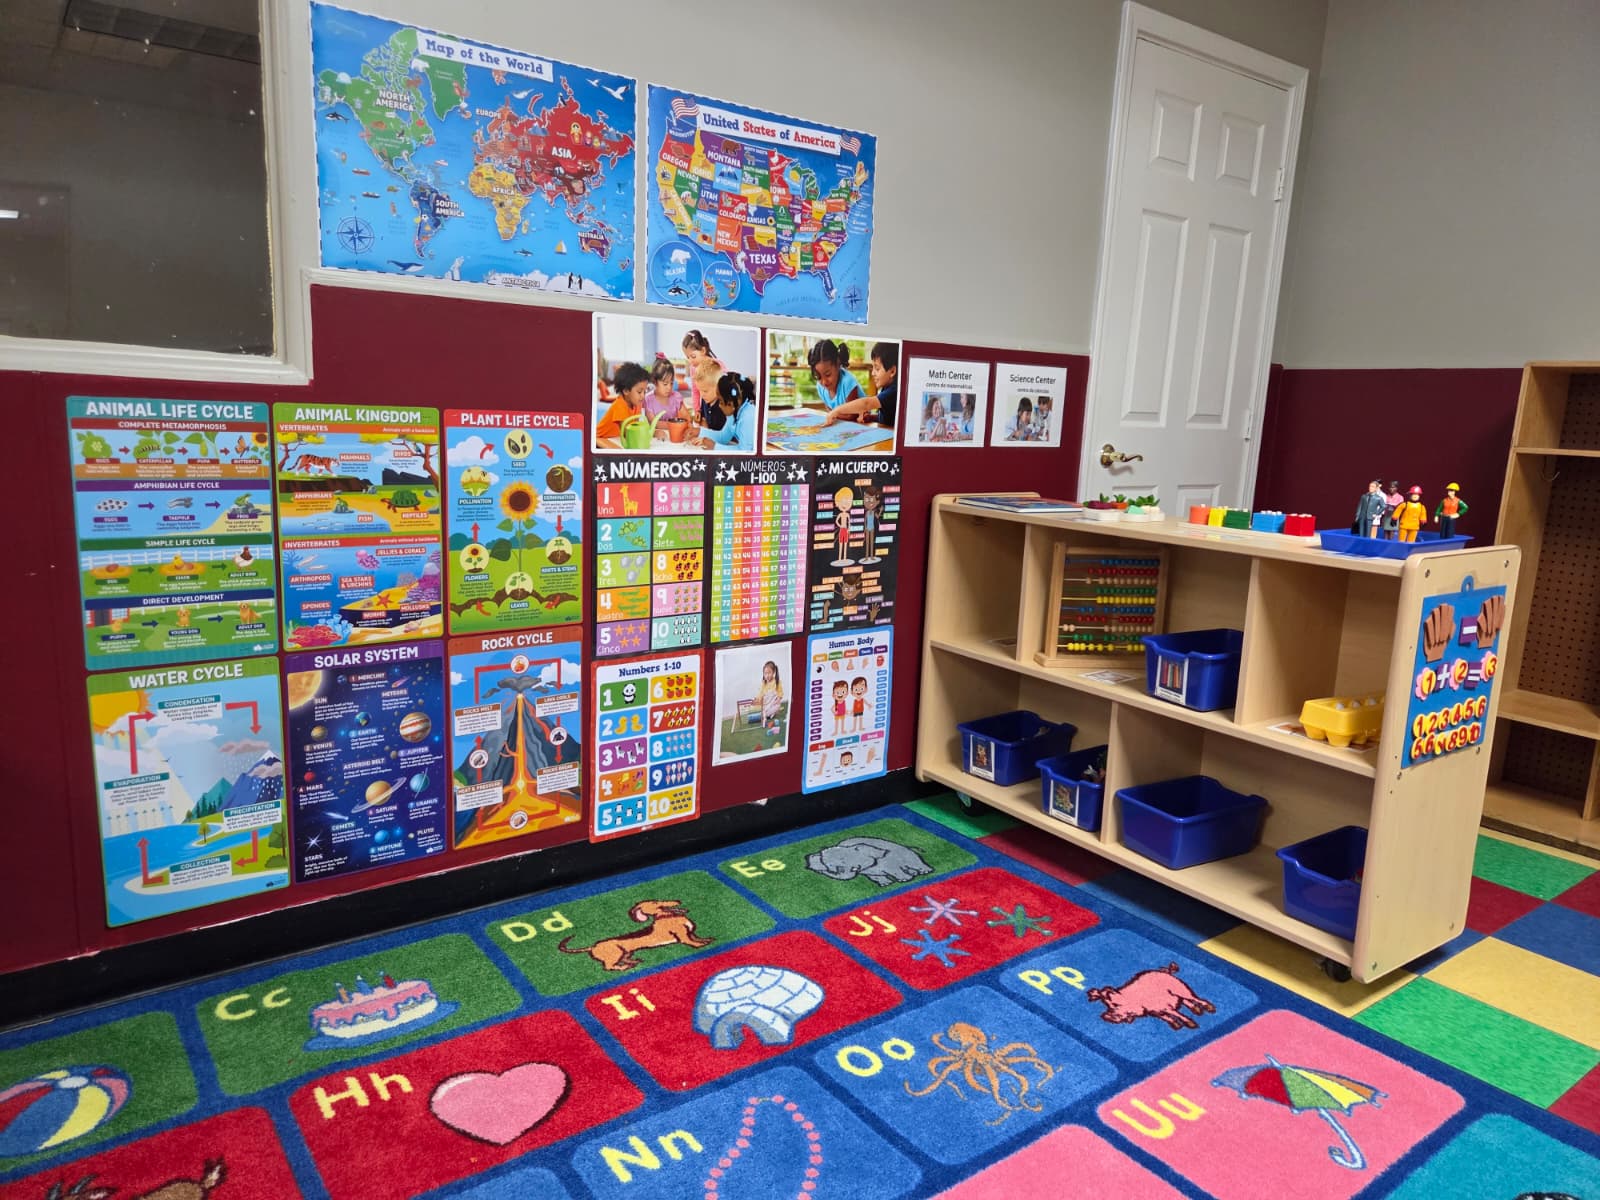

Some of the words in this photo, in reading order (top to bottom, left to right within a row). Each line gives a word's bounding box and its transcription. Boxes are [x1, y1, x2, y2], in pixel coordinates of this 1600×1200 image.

[426, 39, 454, 57] Map
[460, 48, 473, 59] of
[479, 51, 500, 65] the
[506, 57, 544, 74] World
[379, 90, 410, 102] NORTH
[376, 98, 414, 111] AMERICA
[476, 108, 501, 119] EUROPE
[703, 113, 739, 130] United
[743, 121, 776, 137] States
[780, 131, 790, 140] of
[794, 131, 836, 149] America
[551, 147, 572, 159] ASIA
[662, 152, 689, 167] OREGON
[707, 150, 741, 168] MONTANA
[677, 169, 699, 182] NEVADA
[493, 187, 515, 195] AFRICA
[701, 190, 718, 201] UTAH
[770, 186, 786, 195] IOWA
[436, 200, 459, 208] SOUTH
[436, 208, 464, 217] AMERICA
[719, 210, 746, 222] COLORADO
[747, 216, 766, 225] KANSAS
[578, 231, 604, 240] AUSTRALIA
[717, 230, 730, 238] NEW
[717, 238, 738, 247] MEXICO
[749, 254, 777, 264] TEXAS
[929, 370, 946, 379] Math
[949, 371, 972, 380] Center
[1010, 374, 1034, 383] Science
[1036, 376, 1056, 384] Center
[86, 402, 157, 417] ANIMAL
[161, 403, 197, 418] LIFE
[201, 405, 254, 420] CYCLE
[295, 408, 352, 420] ANIMAL
[356, 409, 421, 423] KINGDOM
[118, 421, 160, 429] COMPLETE
[162, 422, 227, 430] METAMORPHOSIS
[461, 413, 503, 426] PLANT
[505, 415, 531, 427] LIFE
[533, 416, 570, 427] CYCLE
[610, 459, 691, 480] NÚMEROS
[740, 461, 786, 472] NÚMEROS
[829, 462, 844, 474] MI
[846, 461, 888, 473] CUERPO
[750, 473, 777, 484] 1-100
[604, 487, 609, 504] 1
[657, 486, 668, 503] 6
[597, 505, 614, 514] Uno
[600, 524, 612, 541] 2
[657, 521, 668, 537] 7
[285, 540, 340, 548] INVERTEBRATES
[601, 559, 612, 576] 3
[657, 554, 667, 570] 8
[143, 597, 170, 605] DIRECT
[171, 594, 224, 603] DEVELOPMENT
[600, 593, 612, 609] 4
[657, 588, 667, 604] 9
[600, 627, 611, 644] 5
[653, 621, 669, 639] 10
[482, 636, 514, 650] ROCK
[517, 632, 553, 645] CYCLE
[829, 640, 854, 649] Human
[857, 637, 874, 645] Body
[314, 653, 360, 668] SOLAR
[365, 647, 419, 662] SYSTEM
[128, 670, 188, 689] WATER
[192, 665, 243, 680] CYCLE
[619, 664, 660, 677] Numbers
[664, 662, 681, 671] 1-10
[1426, 673, 1433, 690] 1
[1458, 662, 1467, 678] 2
[1487, 659, 1497, 676] 3
[603, 689, 613, 706] 1
[653, 682, 663, 698] 6
[165, 697, 215, 707] CONDENSATION
[652, 711, 664, 727] 7
[1417, 716, 1424, 735] 1
[1429, 714, 1438, 733] 2
[1439, 710, 1449, 729] 3
[1453, 704, 1461, 723] 4
[1464, 699, 1473, 718] 5
[1477, 698, 1485, 715] 6
[602, 719, 613, 736] 2
[652, 741, 663, 757] 8
[1414, 738, 1423, 758] 5
[1425, 736, 1435, 753] 6
[1447, 732, 1457, 751] 8
[1459, 726, 1468, 746] 9
[602, 749, 613, 766] 3
[113, 775, 160, 786] EVAPORATION
[652, 769, 662, 786] 9
[601, 780, 613, 796] 4
[230, 802, 275, 815] PRECIPITATION
[376, 805, 397, 813] SATURN
[650, 797, 670, 816] 10
[601, 808, 613, 825] 5
[377, 843, 402, 851] NEPTUNE
[180, 858, 220, 869] COLLECTION
[305, 854, 323, 862] STARS
[729, 857, 786, 881] Ee
[499, 910, 574, 944] Dd
[848, 907, 898, 938] Jj
[1018, 963, 1087, 996] Pp
[214, 986, 292, 1023] Cc
[600, 987, 656, 1022] Ii
[835, 1037, 916, 1078] Oo
[312, 1070, 413, 1121] Hh
[1112, 1090, 1208, 1141] Uu
[597, 1125, 703, 1185] Nn
